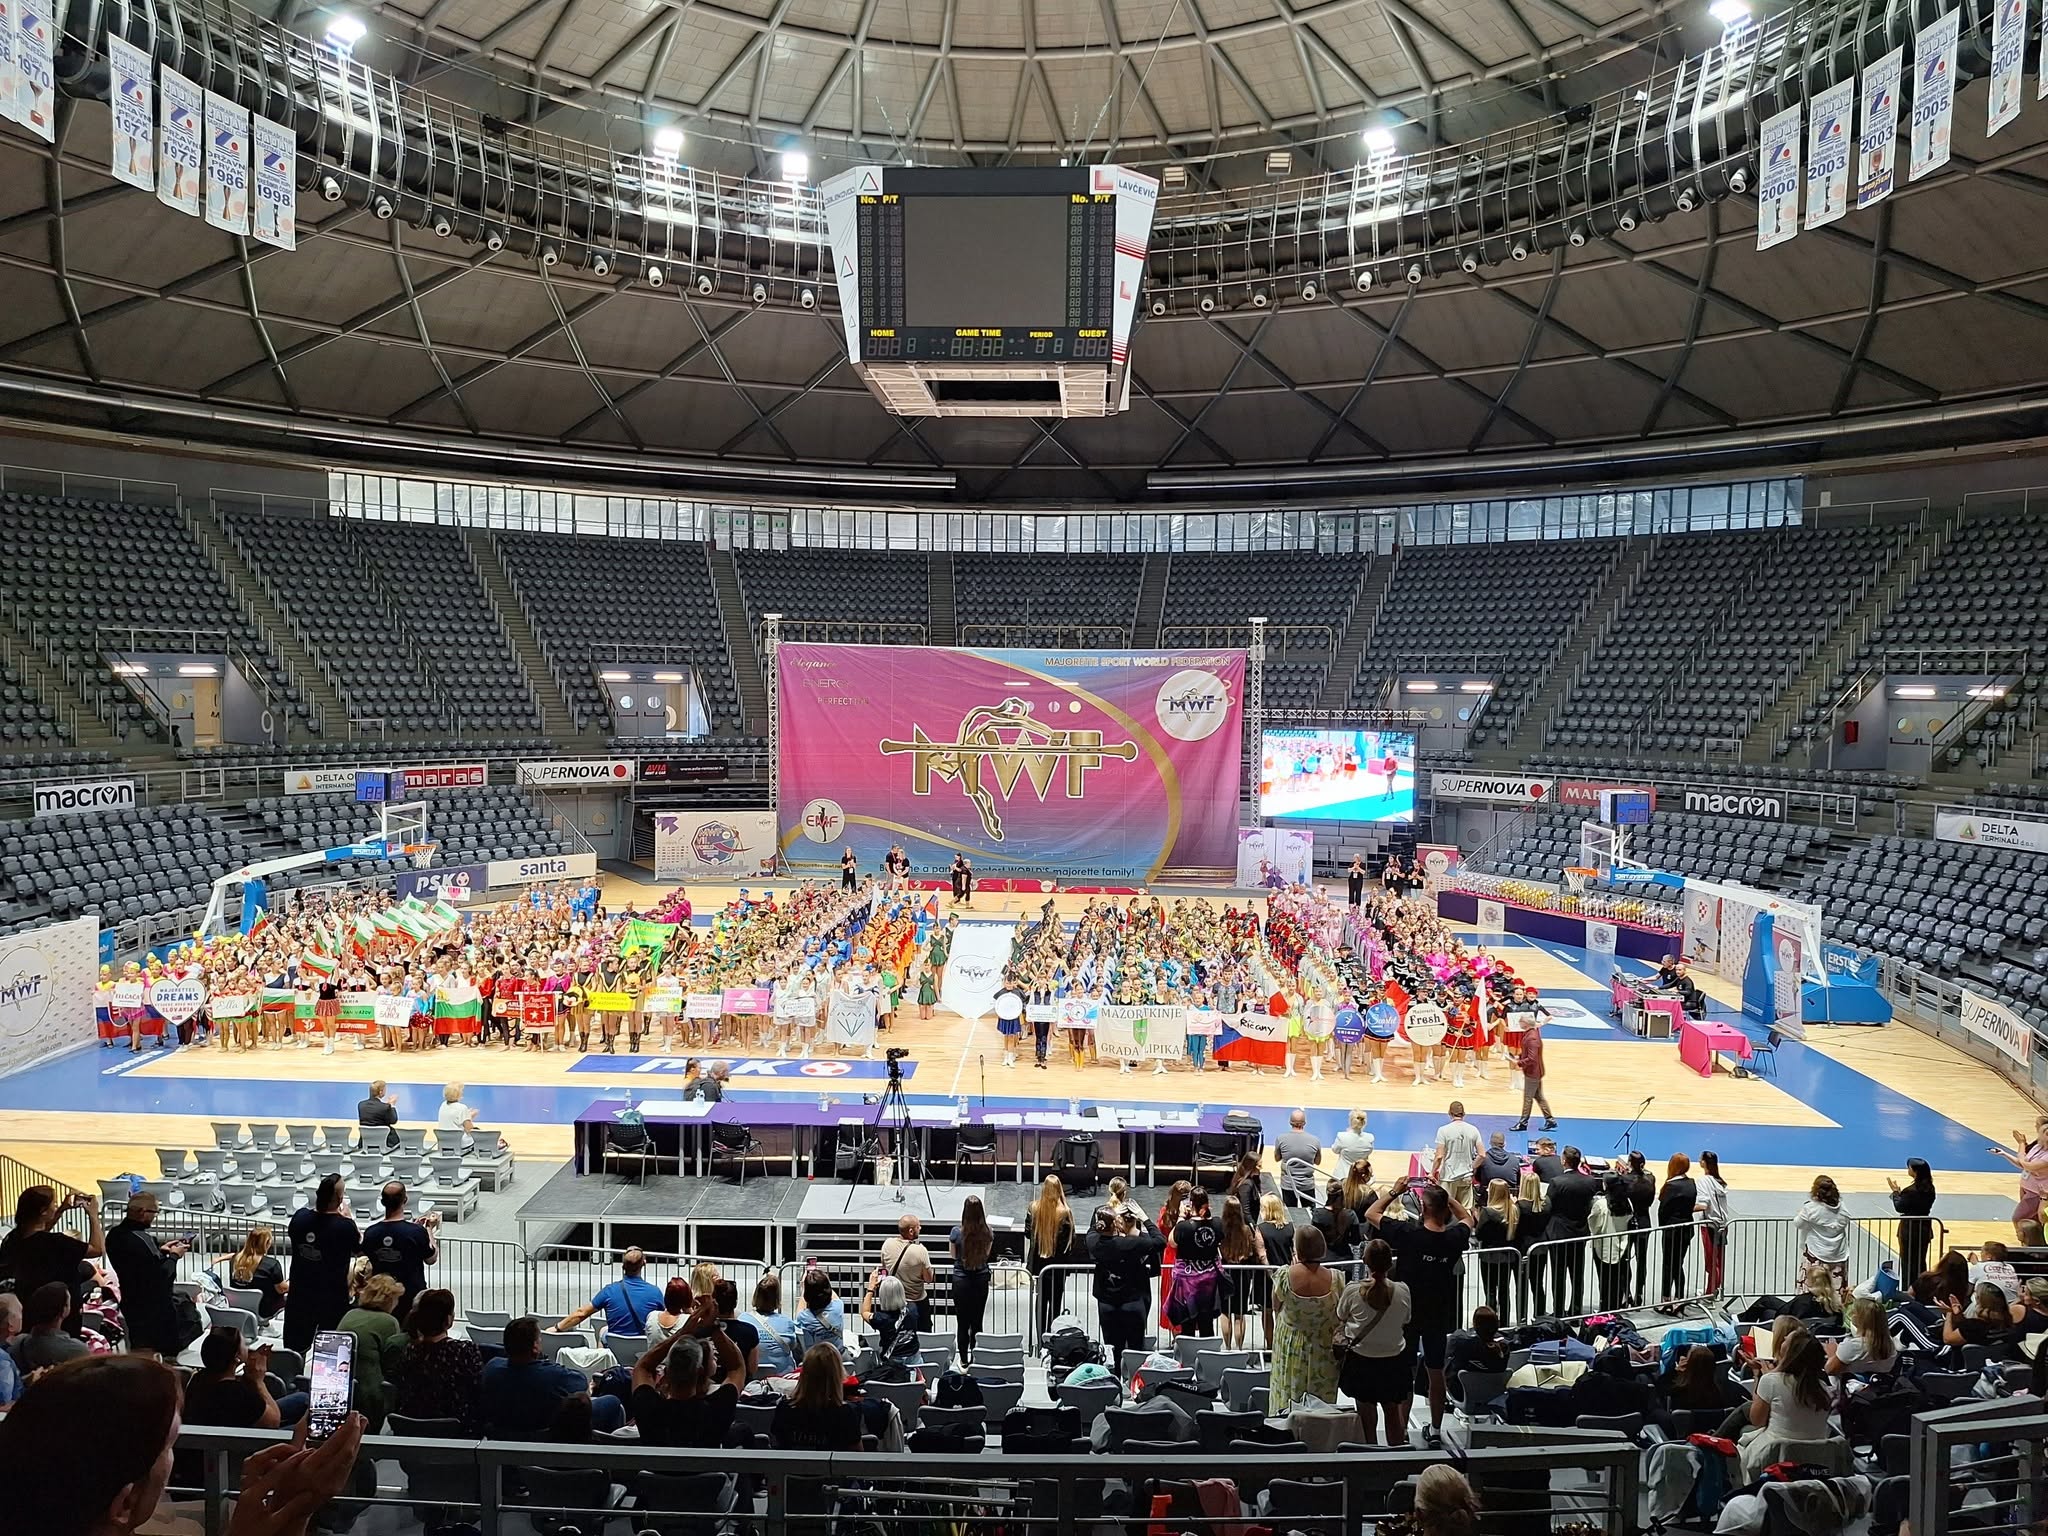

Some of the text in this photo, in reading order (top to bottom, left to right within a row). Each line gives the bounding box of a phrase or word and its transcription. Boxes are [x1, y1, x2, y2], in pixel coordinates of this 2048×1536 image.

[18, 54, 53, 89] 1970.
[119, 109, 149, 129] PRVAK
[1914, 96, 1951, 127] 2005.
[116, 115, 152, 142] 1974.
[167, 135, 196, 155] PRVAK
[1861, 125, 1896, 154] 2003.
[211, 159, 244, 177] PRVAK
[1808, 155, 1847, 181] 2003.
[207, 166, 248, 190] 1986.
[257, 184, 294, 208] 1998.
[860, 195, 899, 204] No. P/T
[1072, 194, 1111, 204] No. P/T
[1761, 178, 1798, 204] 2000.
[955, 329, 1001, 337] GAME TIME
[1045, 656, 1231, 667] MAJORETTE SPORT WORLD FEDERATION
[1169, 694, 1216, 712] MWF
[912, 722, 1102, 803] MWF
[315, 774, 344, 782] DELTA
[525, 765, 610, 780] SUPERNOVA
[1440, 778, 1526, 796] SUPERNOVA
[35, 784, 133, 811] macron
[1685, 792, 1780, 818] macron
[1981, 823, 2019, 836] DELTA
[1981, 834, 2019, 845] TERMINALI
[519, 859, 567, 877] santa
[1053, 866, 1100, 877] majorette
[1102, 866, 1135, 877] family!
[415, 873, 457, 894] PSK
[1827, 951, 1851, 968] ERST
[1, 974, 42, 1004] MWF
[156, 992, 199, 1002] DREAMS
[1101, 1006, 1182, 1020] MAŽORETKINJE
[1409, 1014, 1441, 1026] Fresh
[1961, 999, 2020, 1051] SUPERNOVA
[1101, 1043, 1140, 1057] GRADA
